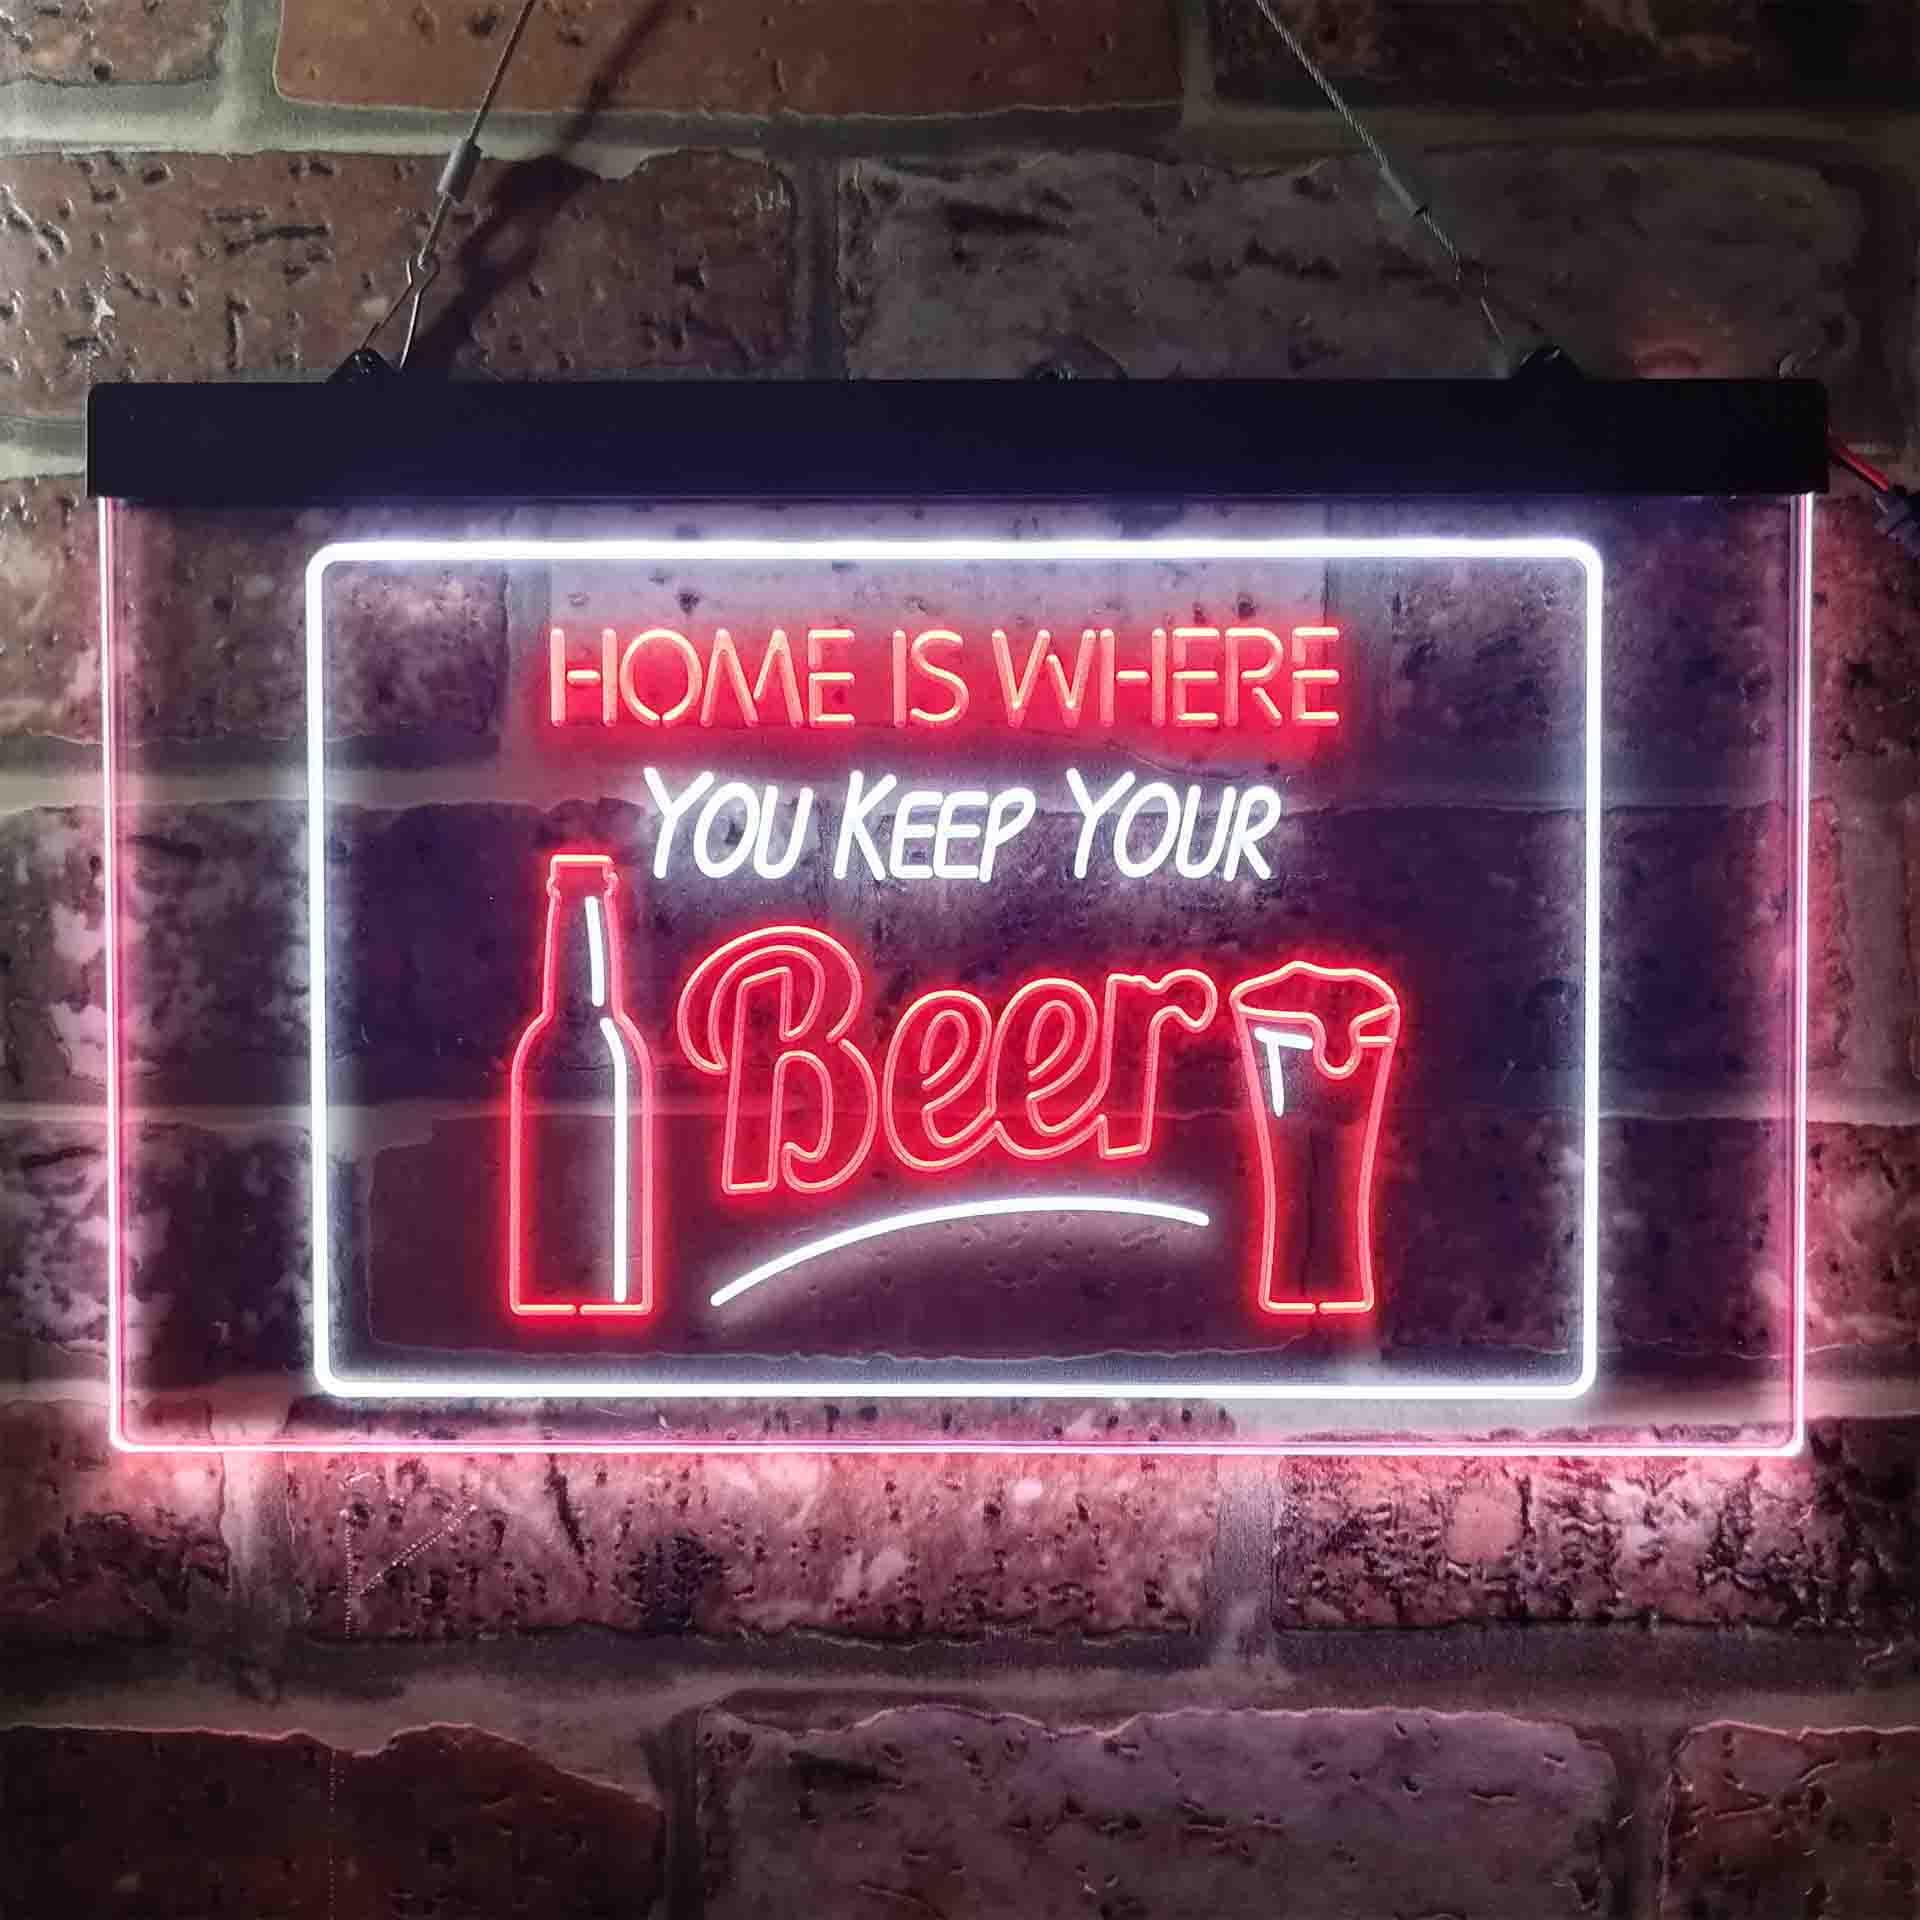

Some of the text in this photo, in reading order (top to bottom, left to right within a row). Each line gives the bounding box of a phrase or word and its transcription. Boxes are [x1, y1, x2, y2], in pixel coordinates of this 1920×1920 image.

[549, 627, 1342, 729] HOME IS WHERE
[644, 768, 1282, 882] YOU KEEP YOUR
[677, 925, 1219, 1195] Beer
